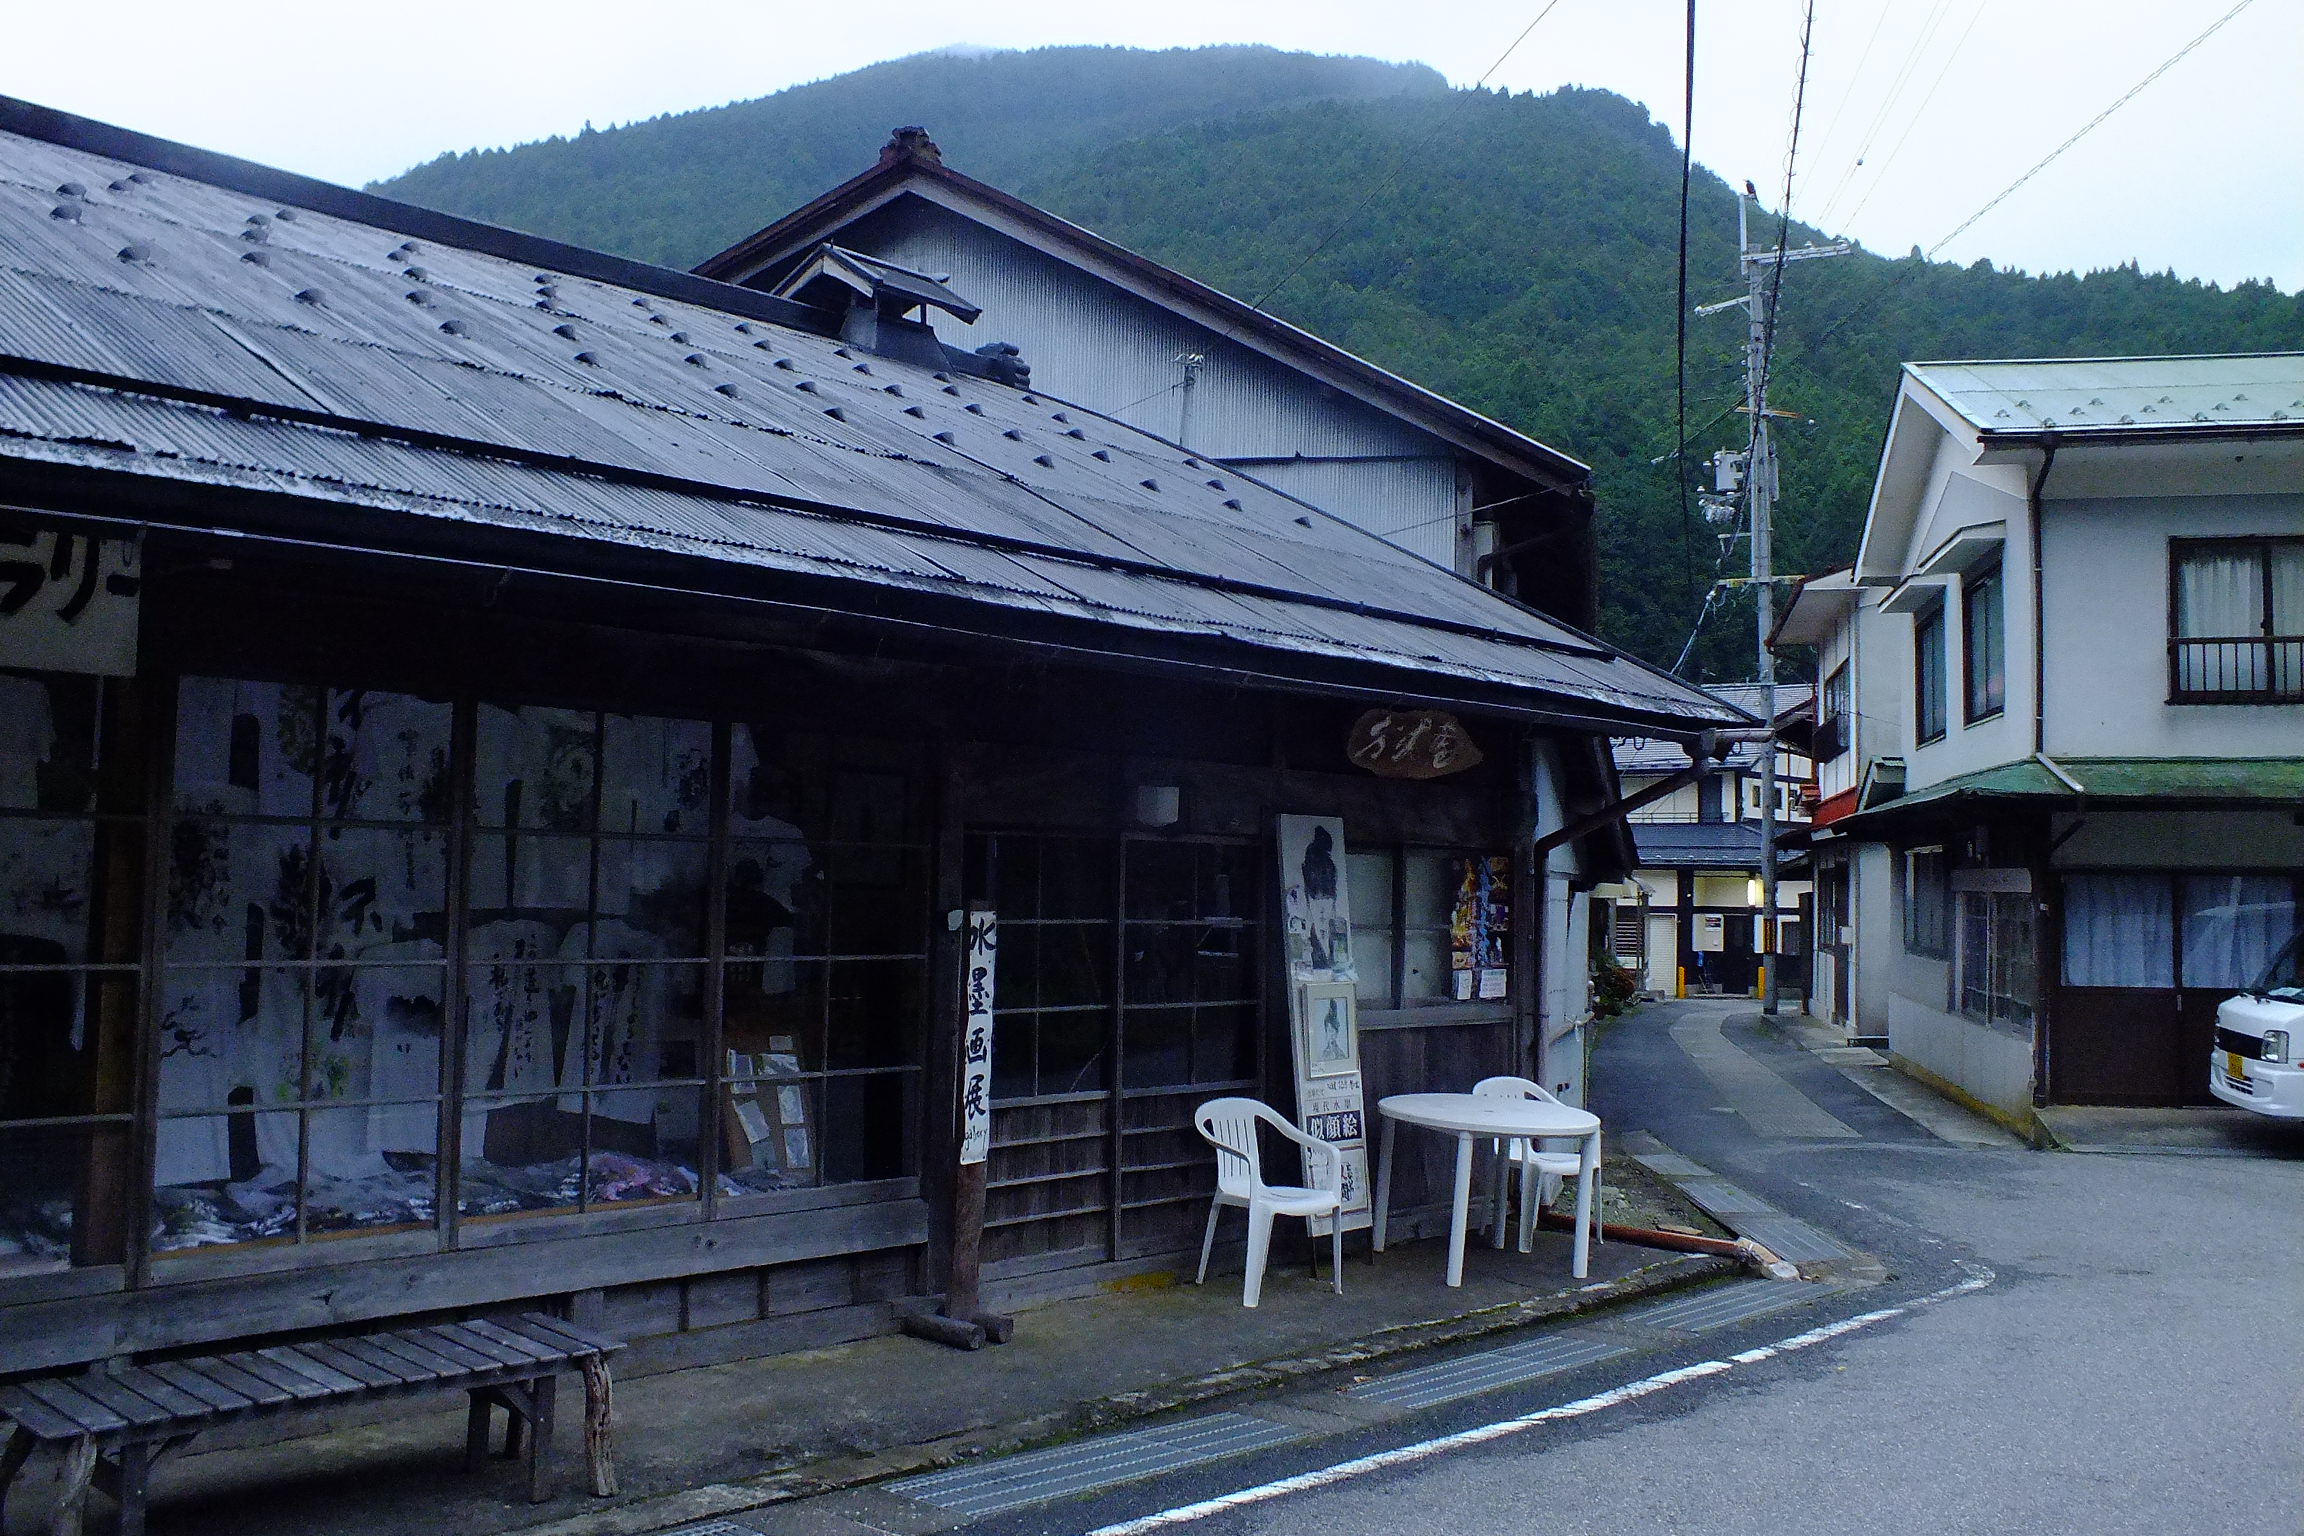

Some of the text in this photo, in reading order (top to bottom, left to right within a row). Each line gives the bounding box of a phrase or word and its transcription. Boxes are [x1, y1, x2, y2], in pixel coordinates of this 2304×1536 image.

[964, 917, 997, 1121] 水墨画展
[1311, 1113, 1358, 1139] 似顔絵
